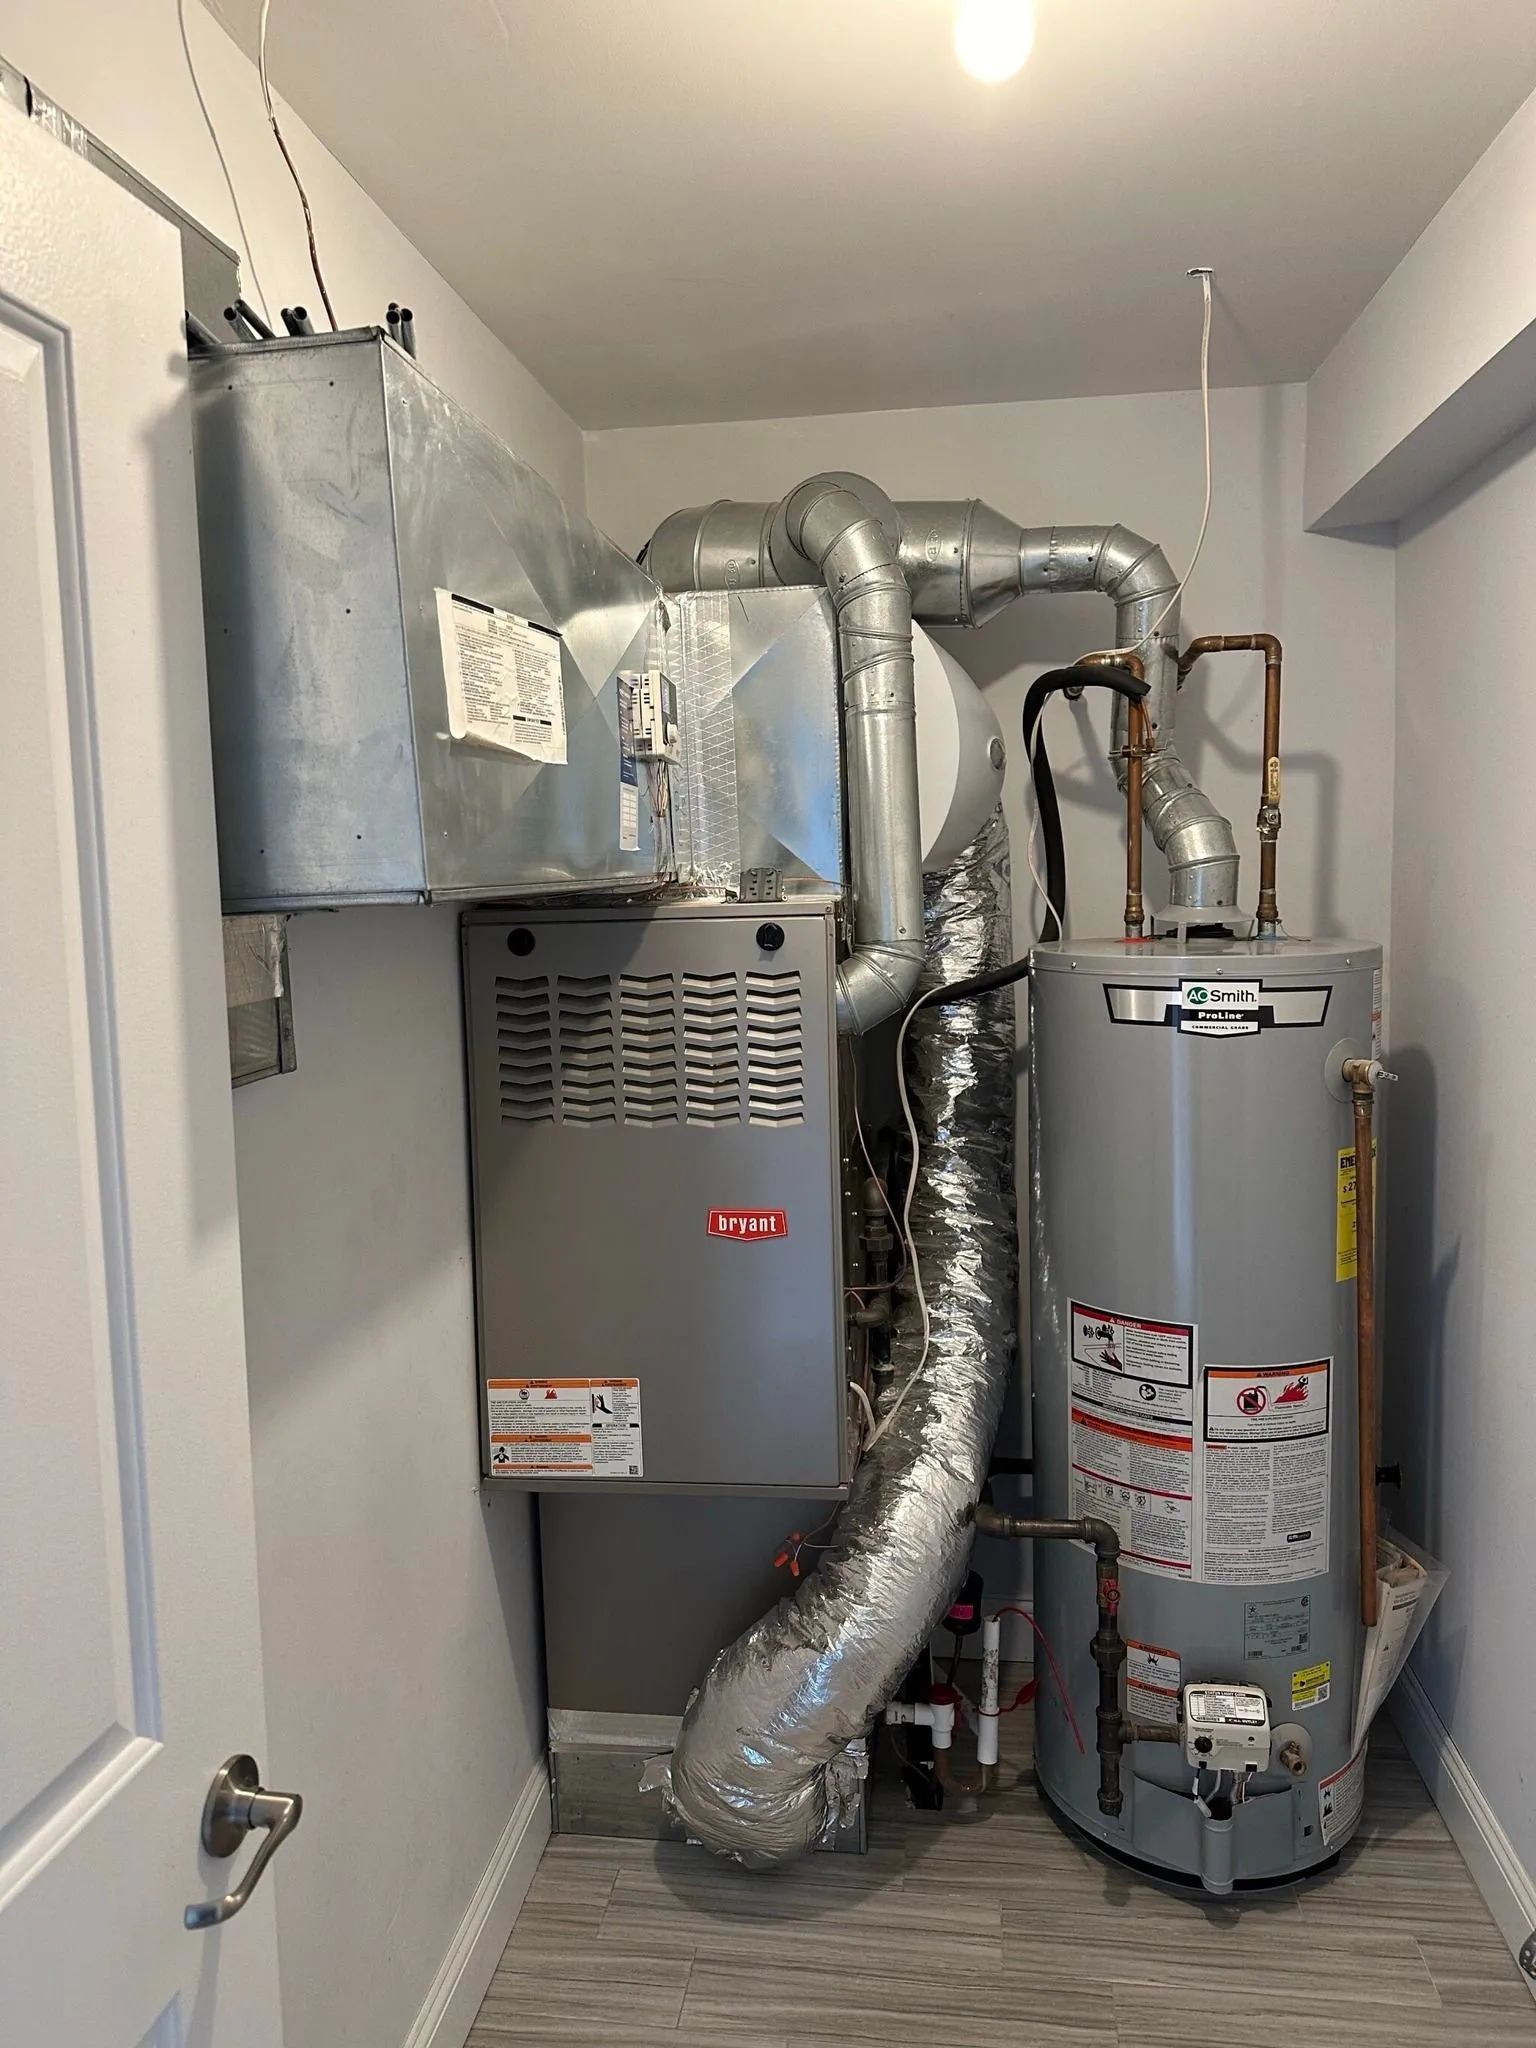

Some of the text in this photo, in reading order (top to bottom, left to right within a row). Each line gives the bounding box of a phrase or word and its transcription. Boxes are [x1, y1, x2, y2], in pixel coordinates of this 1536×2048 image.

[1198, 1011, 1242, 1020] ProLine
[718, 1214, 777, 1234] bryant
[1116, 1319, 1142, 1329] DANGER
